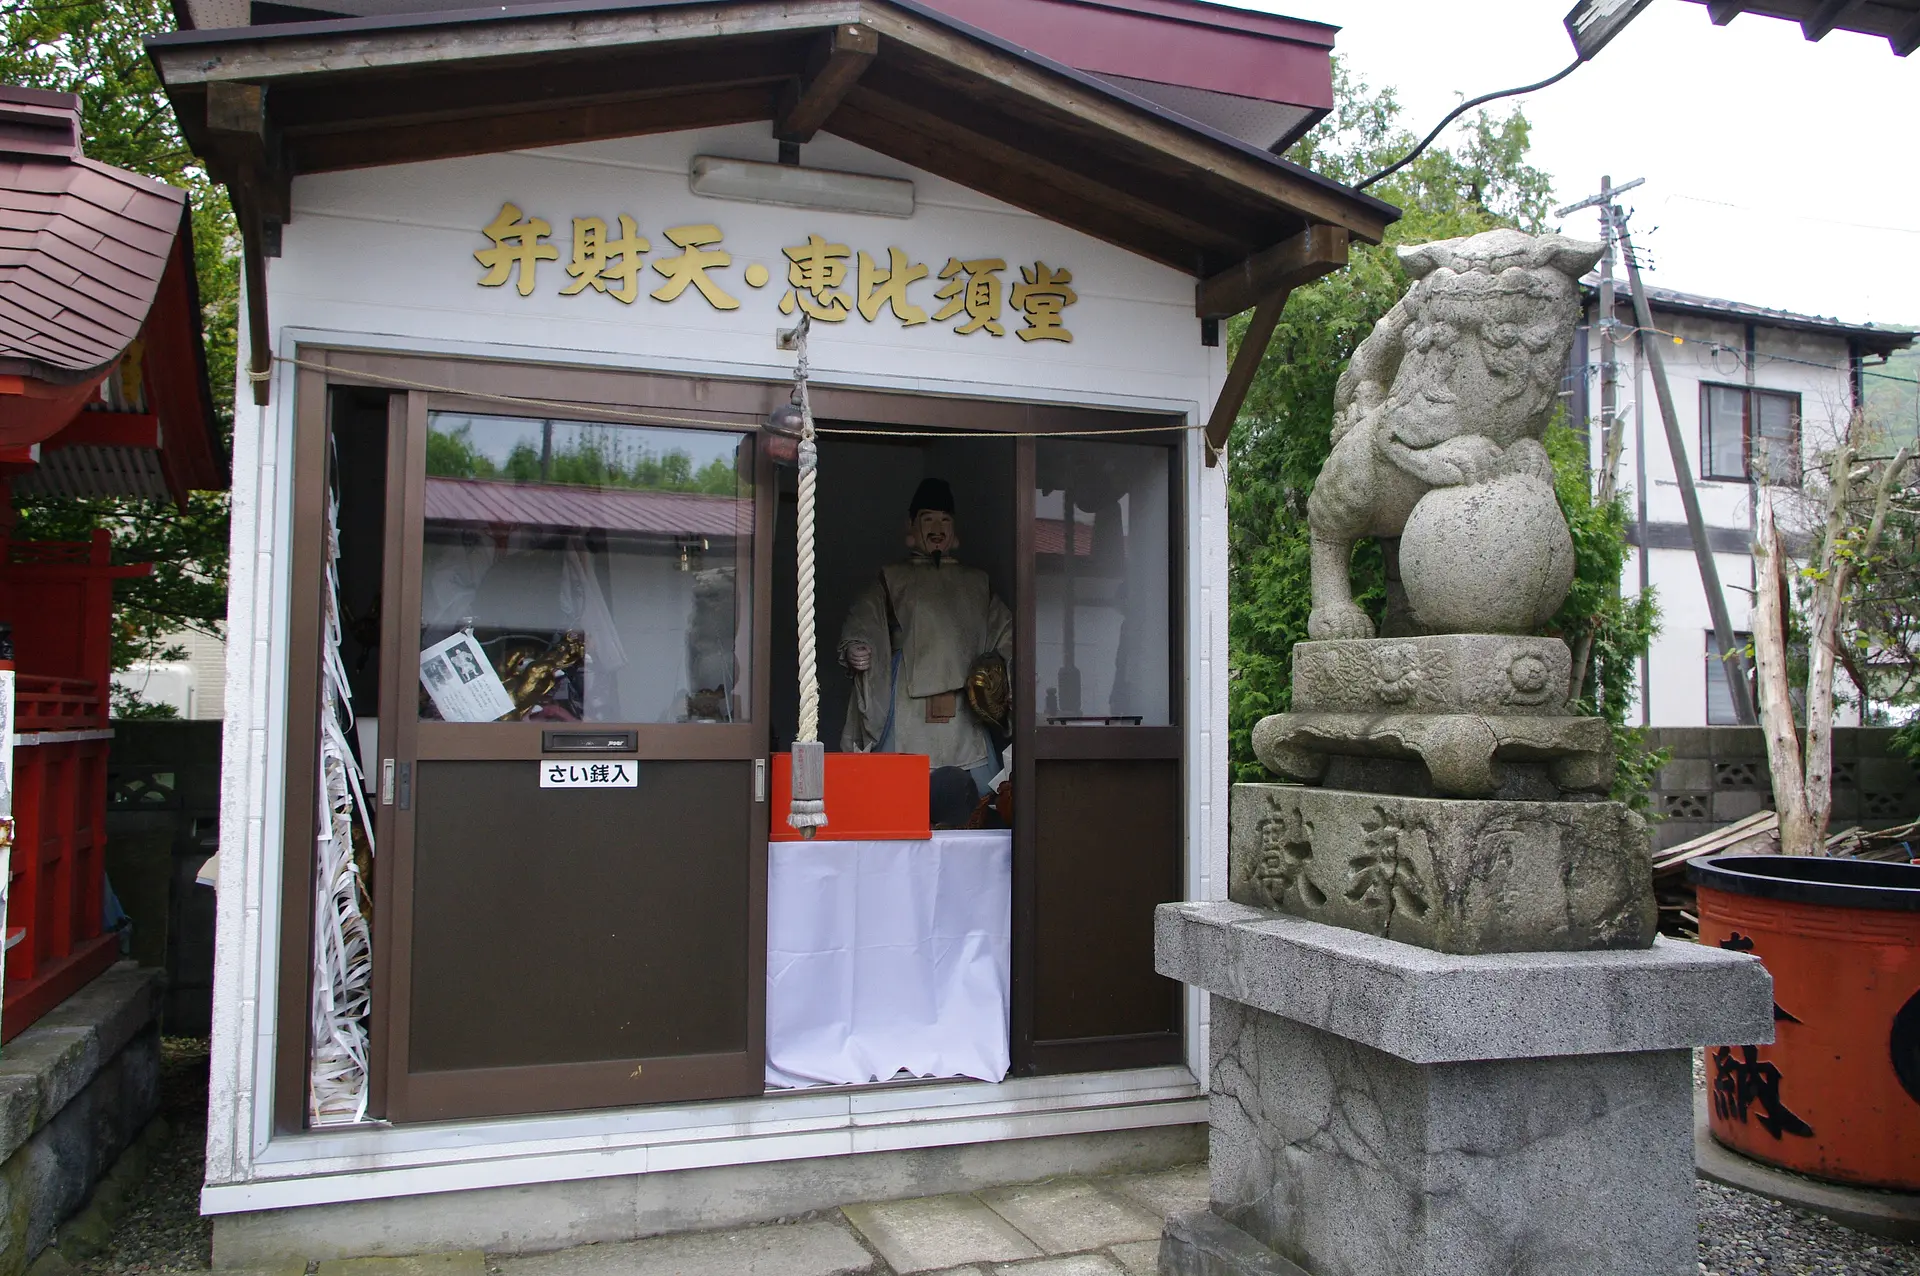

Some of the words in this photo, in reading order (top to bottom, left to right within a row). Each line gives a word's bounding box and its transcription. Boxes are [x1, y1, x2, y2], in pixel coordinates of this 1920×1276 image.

[474, 202, 1079, 344] 弁財天・恵比須堂
[548, 764, 630, 783] さい銭入
